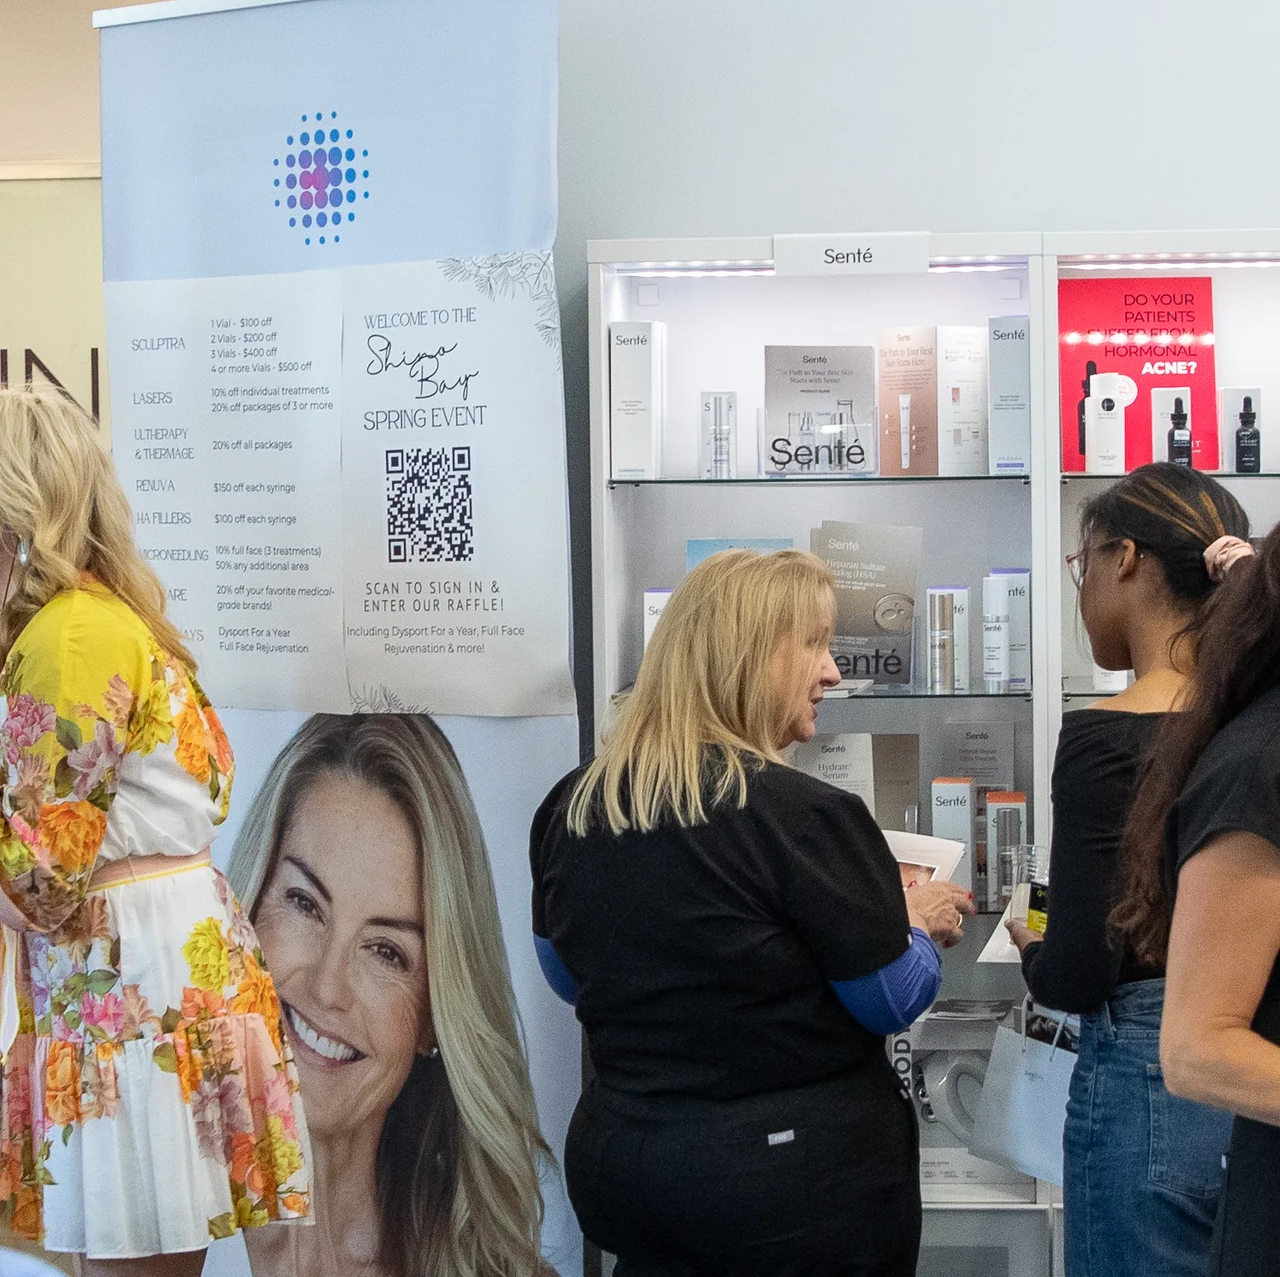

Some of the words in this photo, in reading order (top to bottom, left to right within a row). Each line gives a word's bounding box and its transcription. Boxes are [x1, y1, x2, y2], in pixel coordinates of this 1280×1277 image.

[823, 247, 873, 264] Senté
[1124, 294, 1148, 306] DO
[1150, 293, 1195, 305] YOUR
[215, 318, 231, 328] Vial
[240, 317, 260, 328] $100
[260, 316, 273, 327] off
[364, 311, 428, 329] WELCOME
[431, 309, 449, 324] TO
[452, 307, 477, 323] THE
[1124, 311, 1196, 323] PATIENTS
[217, 333, 236, 343] Vials
[243, 332, 264, 343] $200
[265, 331, 278, 342] off
[615, 335, 648, 346] Senté
[992, 328, 1025, 341] Senté
[131, 337, 186, 351] SCULPTRA
[217, 348, 236, 358] Vials
[243, 347, 265, 358] $400
[265, 347, 278, 357] off
[367, 334, 458, 375] Shino
[1104, 345, 1198, 358] HORMONAL
[802, 355, 827, 364] Senté
[228, 365, 250, 373] more
[252, 363, 271, 373] Vials
[278, 362, 299, 372] $500
[300, 361, 312, 371] off
[1141, 361, 1198, 375] ACNE?
[409, 354, 479, 401] Bay
[211, 388, 227, 397] 10%
[228, 387, 239, 397] off
[240, 386, 280, 396] individual
[281, 385, 330, 395] treatments
[133, 392, 173, 404] LASERS
[211, 403, 229, 412] 20%
[230, 402, 241, 412] off
[242, 402, 281, 413] packages
[282, 401, 292, 410] of
[299, 402, 308, 410] or
[310, 402, 334, 410] more
[364, 409, 427, 430] SPRING
[431, 405, 487, 428] EVENT
[134, 428, 189, 441] ULTHERAPY
[212, 441, 230, 450] 20%
[231, 440, 242, 450] off
[243, 440, 253, 449] all
[254, 440, 293, 451] packages
[770, 438, 865, 465] Senté
[135, 449, 142, 460] &
[143, 447, 194, 460] THERMAGE
[136, 479, 175, 492] RENUVA
[214, 482, 232, 493] $150
[233, 482, 245, 492] off
[245, 482, 265, 492] each
[266, 483, 296, 494] syringe
[137, 512, 150, 524] HA
[152, 512, 192, 524] FILLERS
[214, 513, 233, 524] $100
[234, 514, 246, 524] off
[246, 514, 266, 524] each
[267, 514, 297, 526] syringe
[215, 546, 230, 555] 10%
[231, 545, 244, 555] full
[246, 545, 262, 555] face
[273, 546, 321, 557] treatments)
[828, 538, 860, 552] Senté
[215, 560, 232, 570] 50%
[233, 562, 248, 572] any
[250, 560, 290, 571] additional
[291, 563, 309, 571] area
[831, 568, 852, 579] nalog
[216, 585, 233, 595] 20%
[234, 585, 245, 595] off
[245, 587, 264, 597] your
[265, 586, 296, 596] favorite
[365, 582, 399, 595] SCAN
[405, 581, 422, 594] TO
[429, 581, 461, 594] SIGN
[469, 581, 483, 593] IN
[491, 580, 500, 593] &
[1008, 585, 1025, 597] nté
[217, 601, 241, 611] grade
[243, 600, 272, 610] brands!
[364, 599, 406, 612] ENTER
[413, 599, 440, 612] OUR
[448, 598, 504, 611] RAFFLE!
[218, 626, 250, 638] Dysport
[251, 627, 264, 637] For
[272, 628, 290, 638] Year
[346, 626, 390, 638] Including
[391, 626, 429, 638] Dysport
[431, 626, 447, 636] For
[456, 626, 480, 638] Year,
[481, 625, 499, 636] Full
[501, 625, 525, 636] Face
[219, 641, 234, 651] Full
[235, 642, 254, 652] Face
[256, 642, 309, 654] Rejuvenation
[384, 643, 445, 656] Rejuvenation
[447, 643, 454, 653] &
[456, 643, 485, 654] more!
[834, 648, 901, 675] enté
[966, 732, 989, 740] Senté
[821, 745, 846, 754] Senté
[822, 771, 849, 779] Serum
[935, 795, 967, 807] Senté
